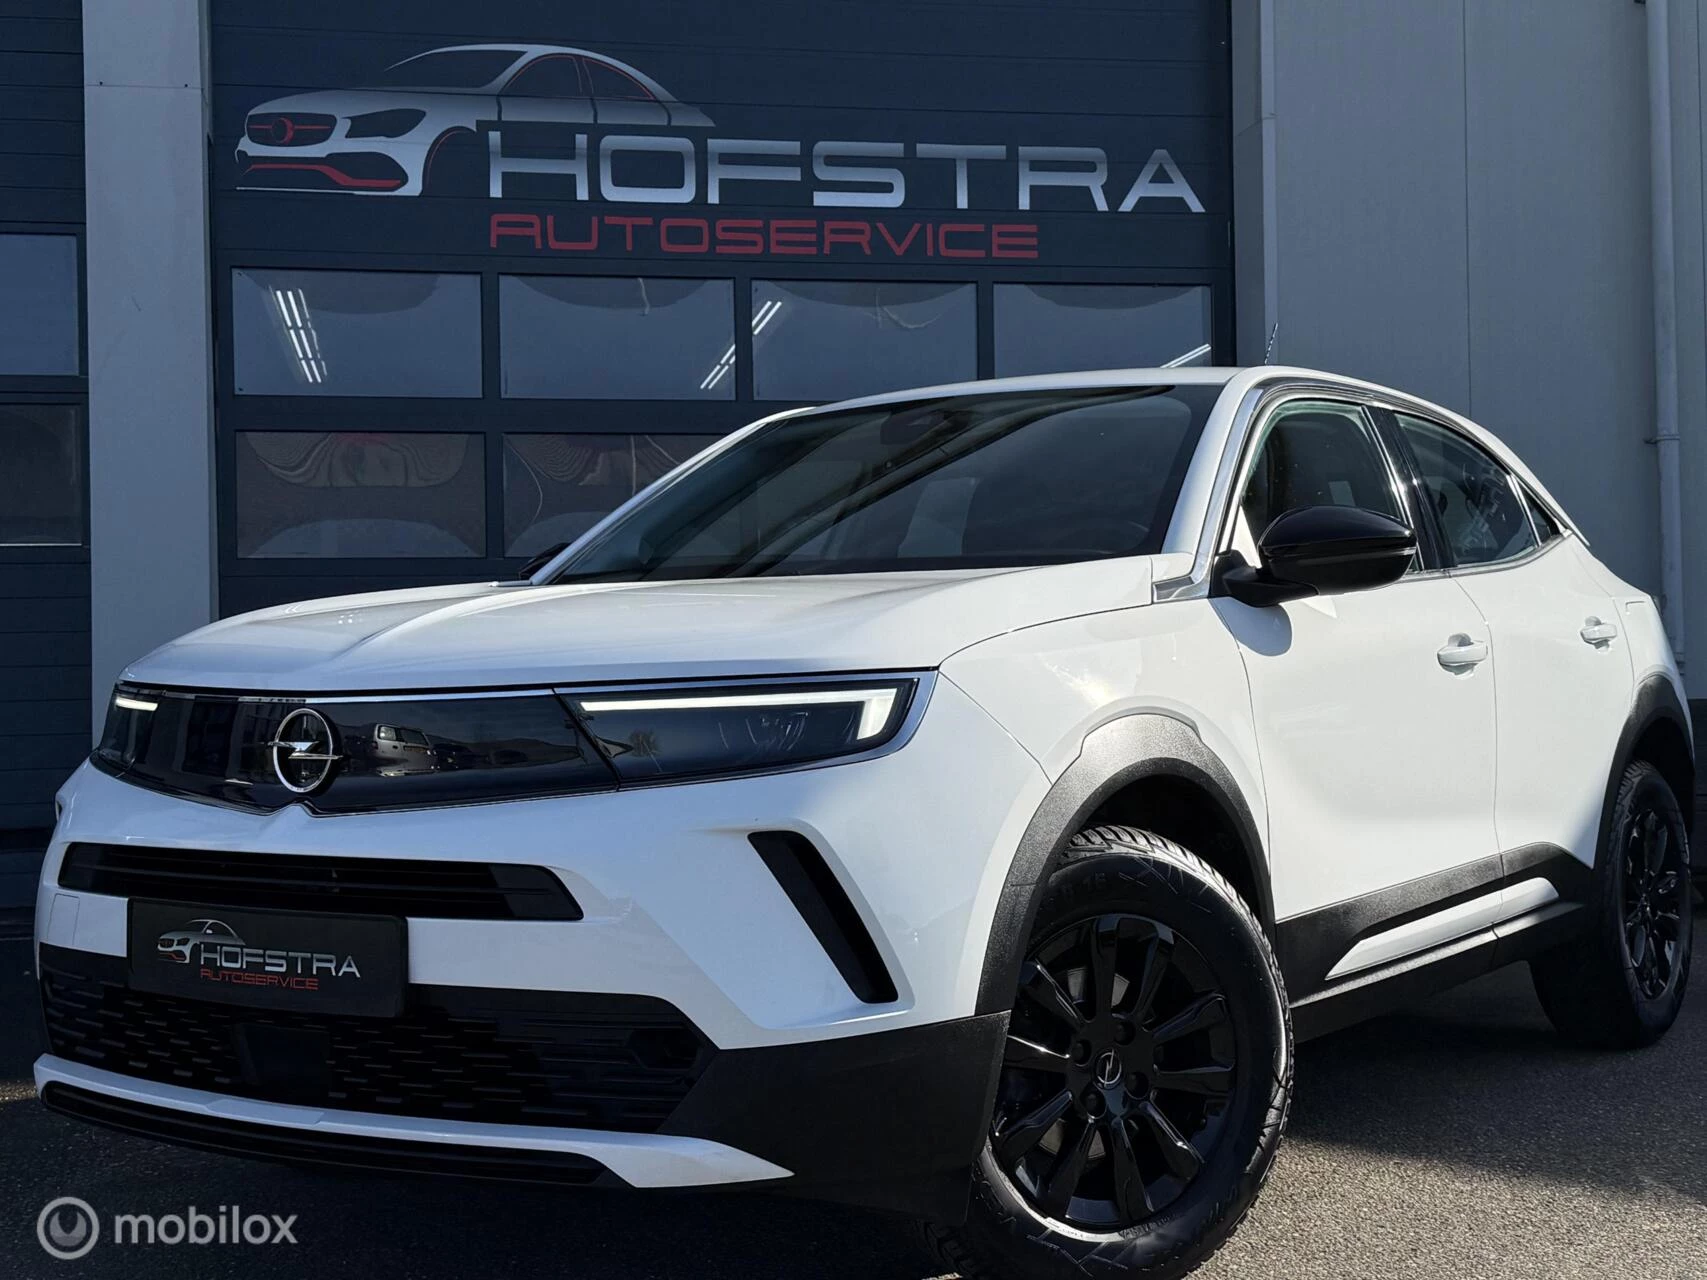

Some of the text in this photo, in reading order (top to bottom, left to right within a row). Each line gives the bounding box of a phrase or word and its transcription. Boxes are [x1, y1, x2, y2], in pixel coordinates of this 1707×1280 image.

[488, 131, 1206, 213] HOFSTRA
[489, 213, 1039, 259] AUTOSERVICE
[200, 944, 361, 978] HOFSTRA
[200, 968, 320, 990] AUTOSERVICE
